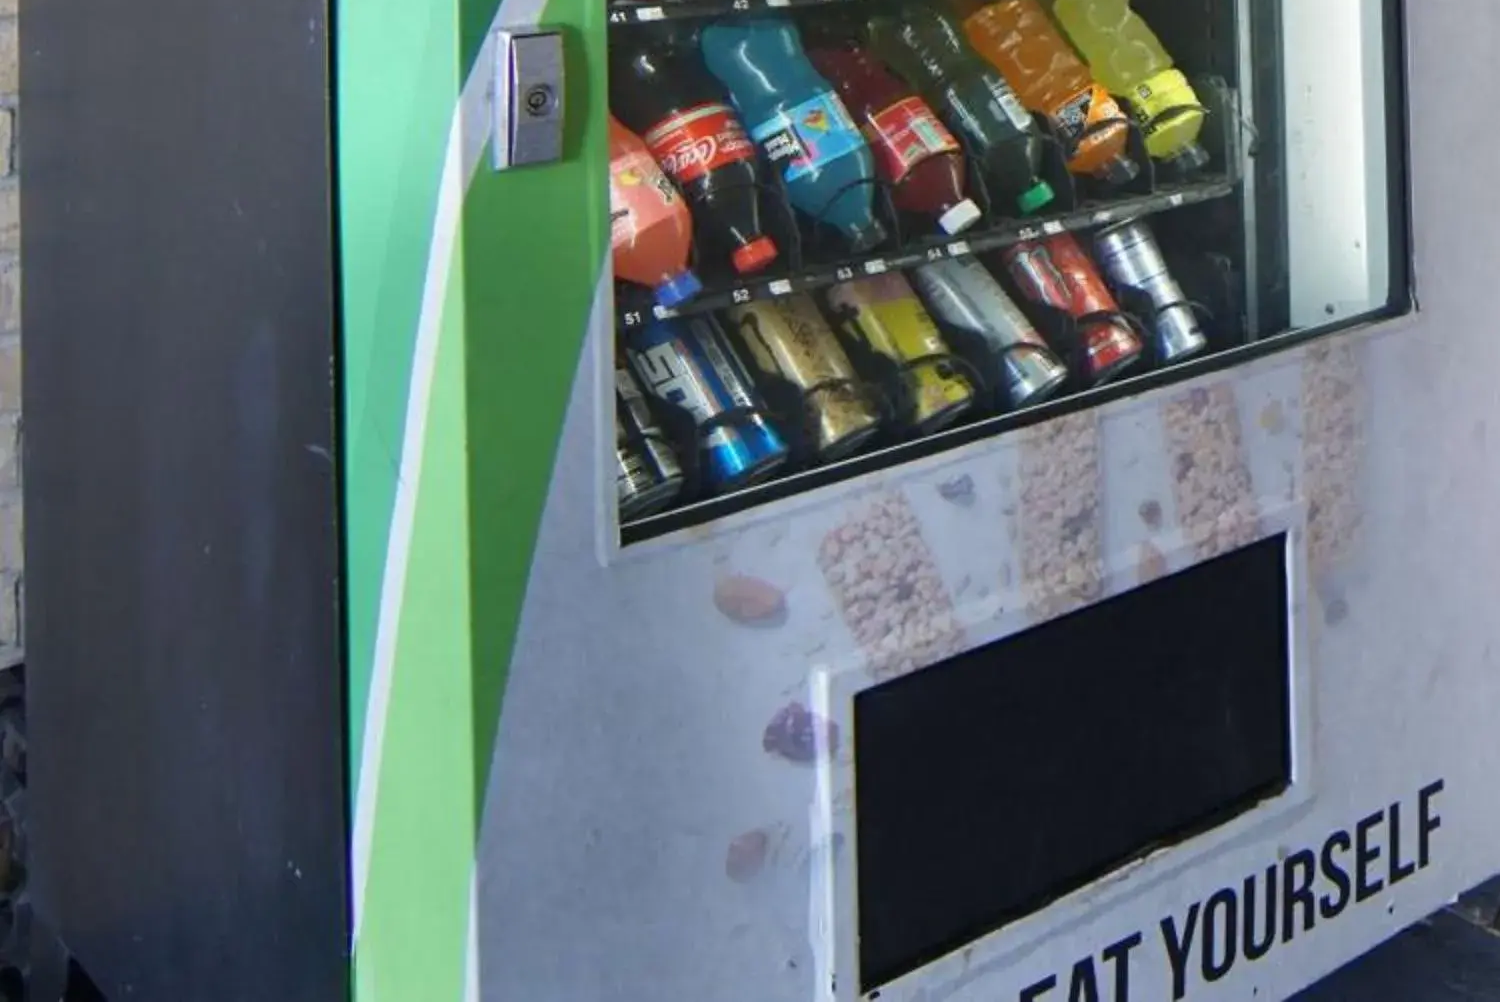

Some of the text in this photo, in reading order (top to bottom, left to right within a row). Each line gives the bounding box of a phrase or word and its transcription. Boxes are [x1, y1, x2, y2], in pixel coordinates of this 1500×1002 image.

[610, 11, 627, 23] 41
[624, 311, 641, 326] 51
[1159, 778, 1444, 1001] YOURSELF
